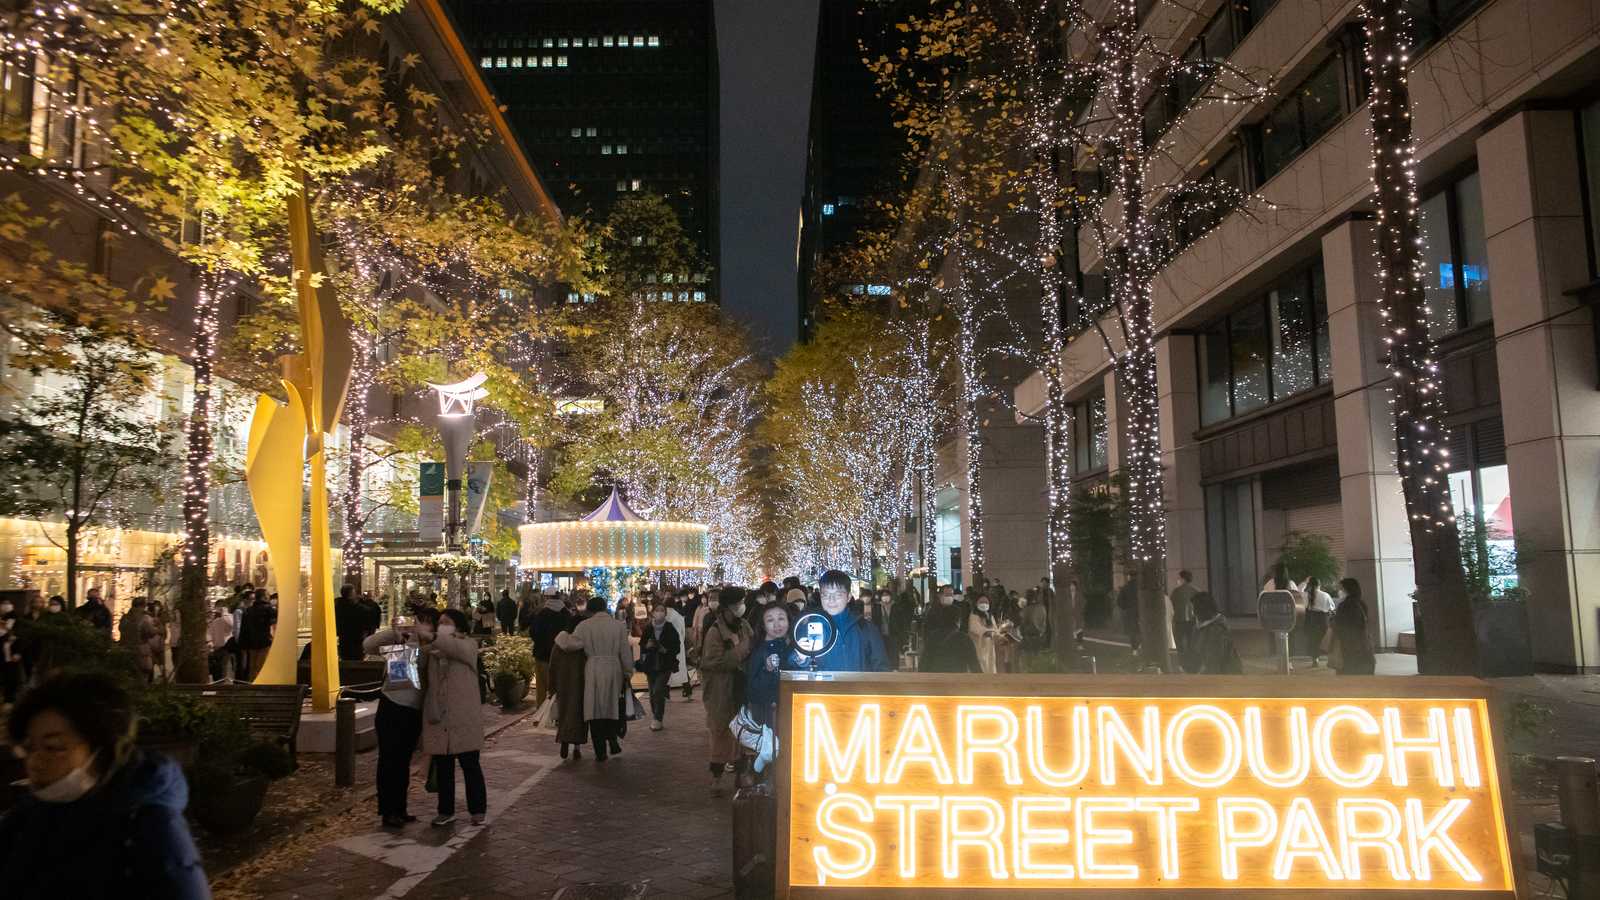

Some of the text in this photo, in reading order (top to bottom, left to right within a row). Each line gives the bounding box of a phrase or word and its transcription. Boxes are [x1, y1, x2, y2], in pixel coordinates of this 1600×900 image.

[803, 702, 1481, 788] MARUNOUCHI
[813, 792, 1483, 882] STREET PARK
